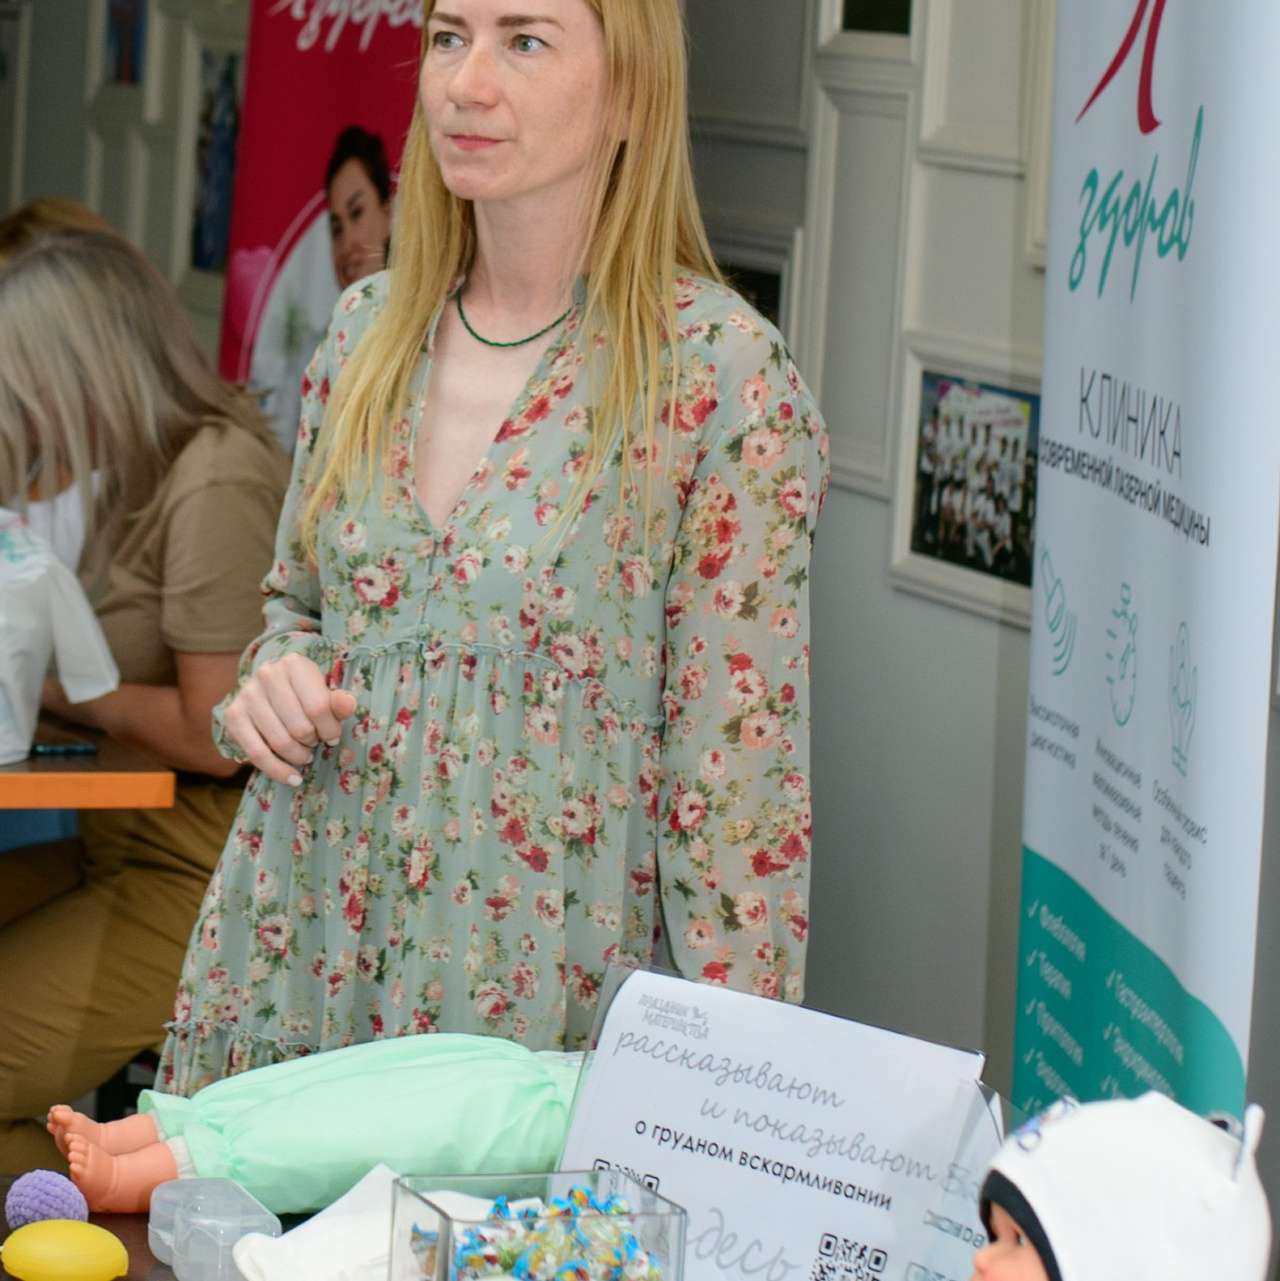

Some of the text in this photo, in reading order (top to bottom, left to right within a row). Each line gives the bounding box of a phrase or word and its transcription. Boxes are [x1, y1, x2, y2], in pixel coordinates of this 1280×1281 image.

[1068, 104, 1204, 304] здоров
[1078, 366, 1183, 480] КЛИНИКА
[612, 1028, 846, 1109] рассказывают
[635, 1120, 646, 1135] о
[651, 1122, 733, 1163] грудном
[738, 1150, 893, 1211] вскармливании
[700, 1097, 726, 1120] и
[731, 1110, 940, 1183] показывают
